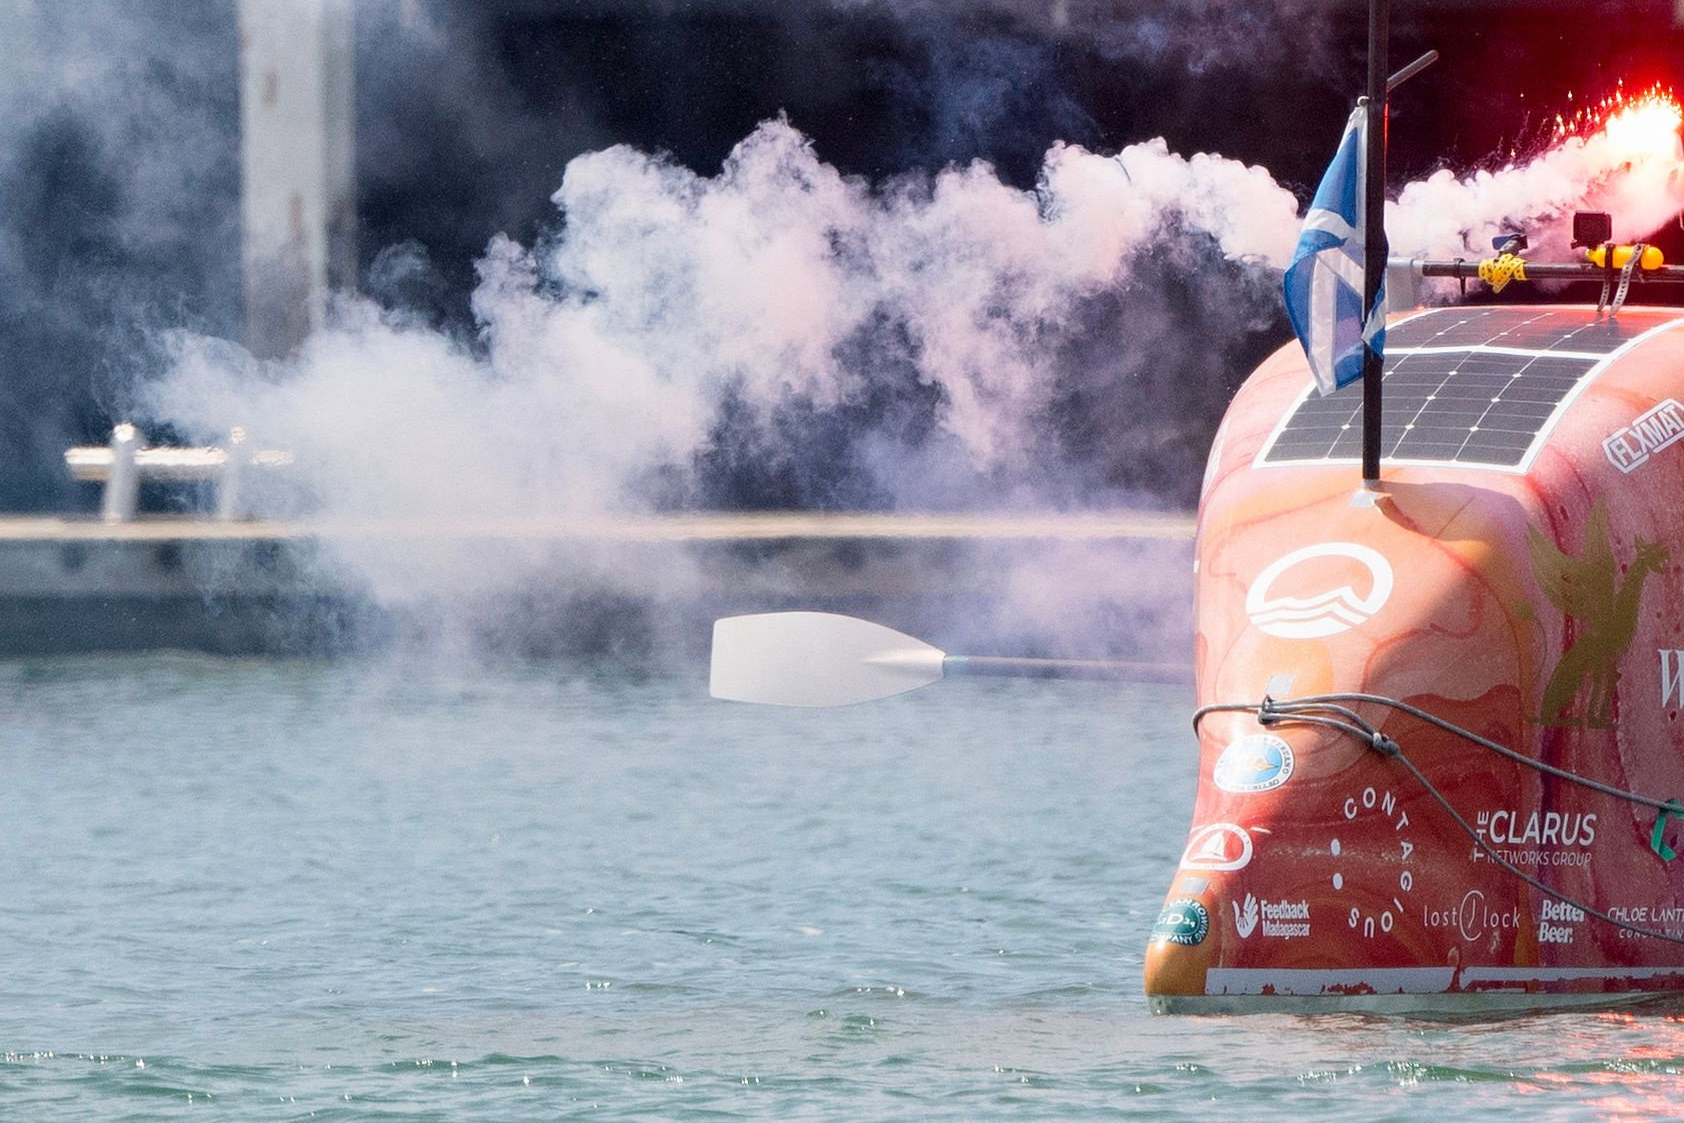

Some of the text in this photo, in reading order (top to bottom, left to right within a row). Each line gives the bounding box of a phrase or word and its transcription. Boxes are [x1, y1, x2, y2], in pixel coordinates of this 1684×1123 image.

[1489, 809, 1598, 847] CLARUS
[1551, 851, 1593, 867] GROUP
[1260, 898, 1310, 920] Feedback
[1541, 899, 1585, 922] Better
[1607, 906, 1649, 922] CHLOE
[1262, 920, 1311, 941] Madagascar
